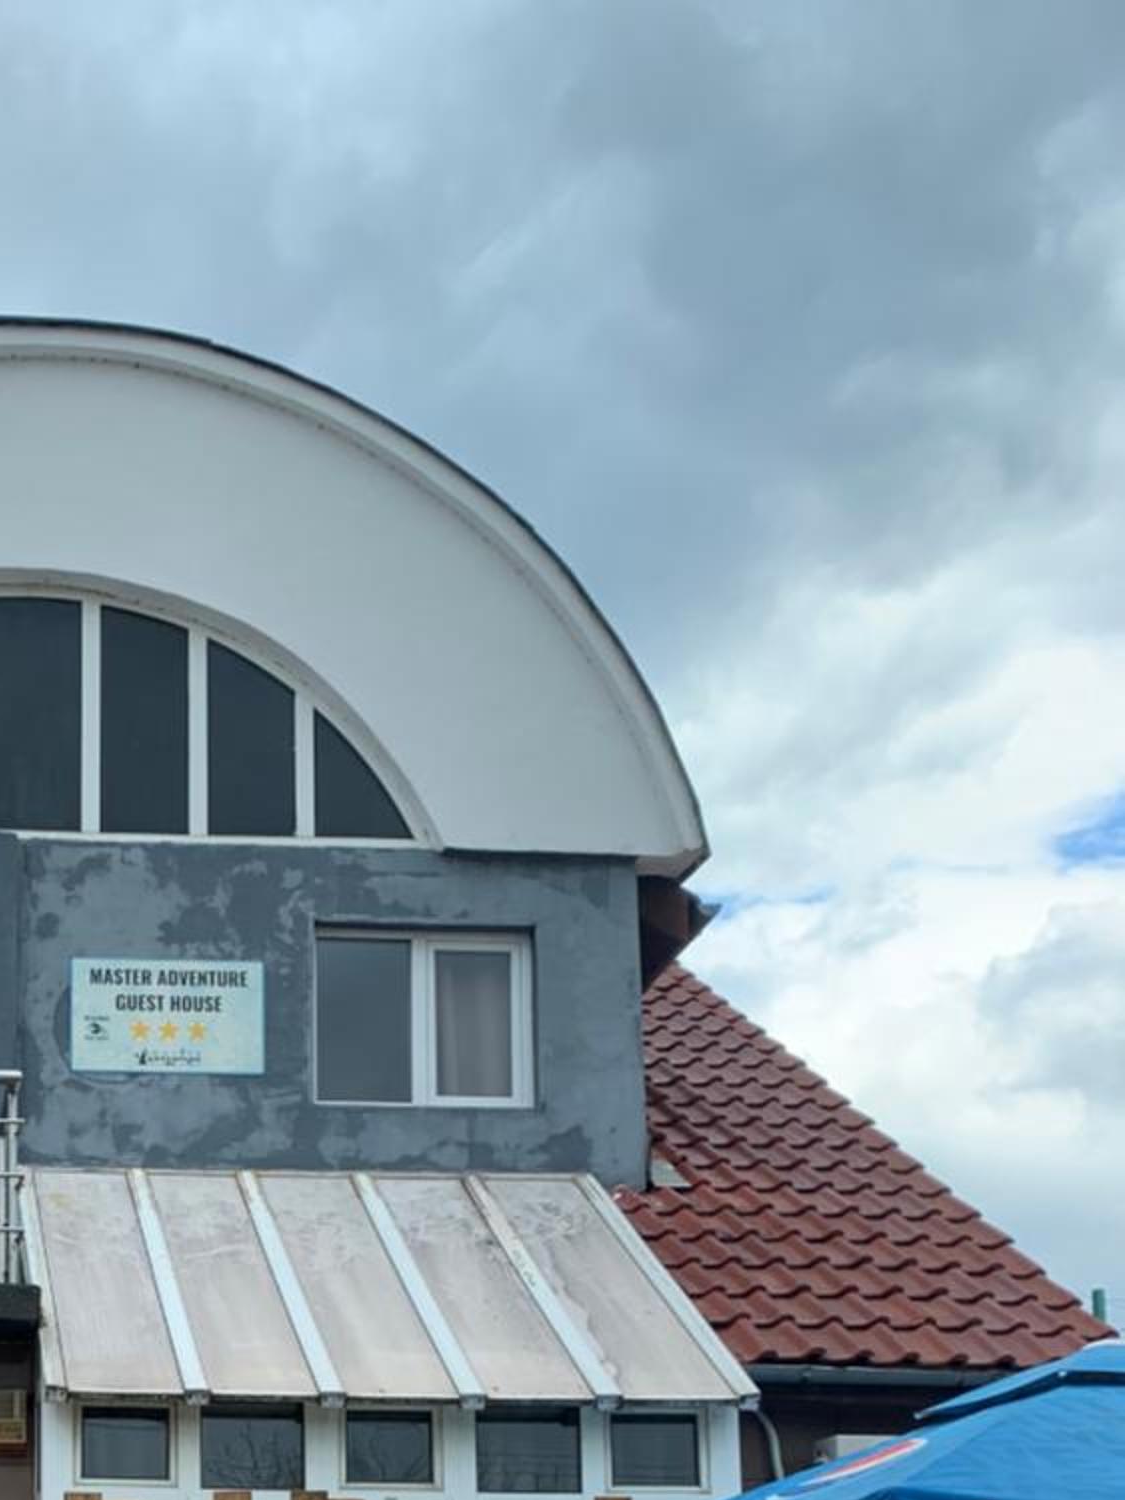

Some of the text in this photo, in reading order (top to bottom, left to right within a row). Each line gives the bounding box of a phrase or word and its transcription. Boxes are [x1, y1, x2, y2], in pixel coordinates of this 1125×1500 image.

[89, 968, 248, 988] MASTER ADVENTURE
[115, 994, 222, 1013] GUEST HOUSE
